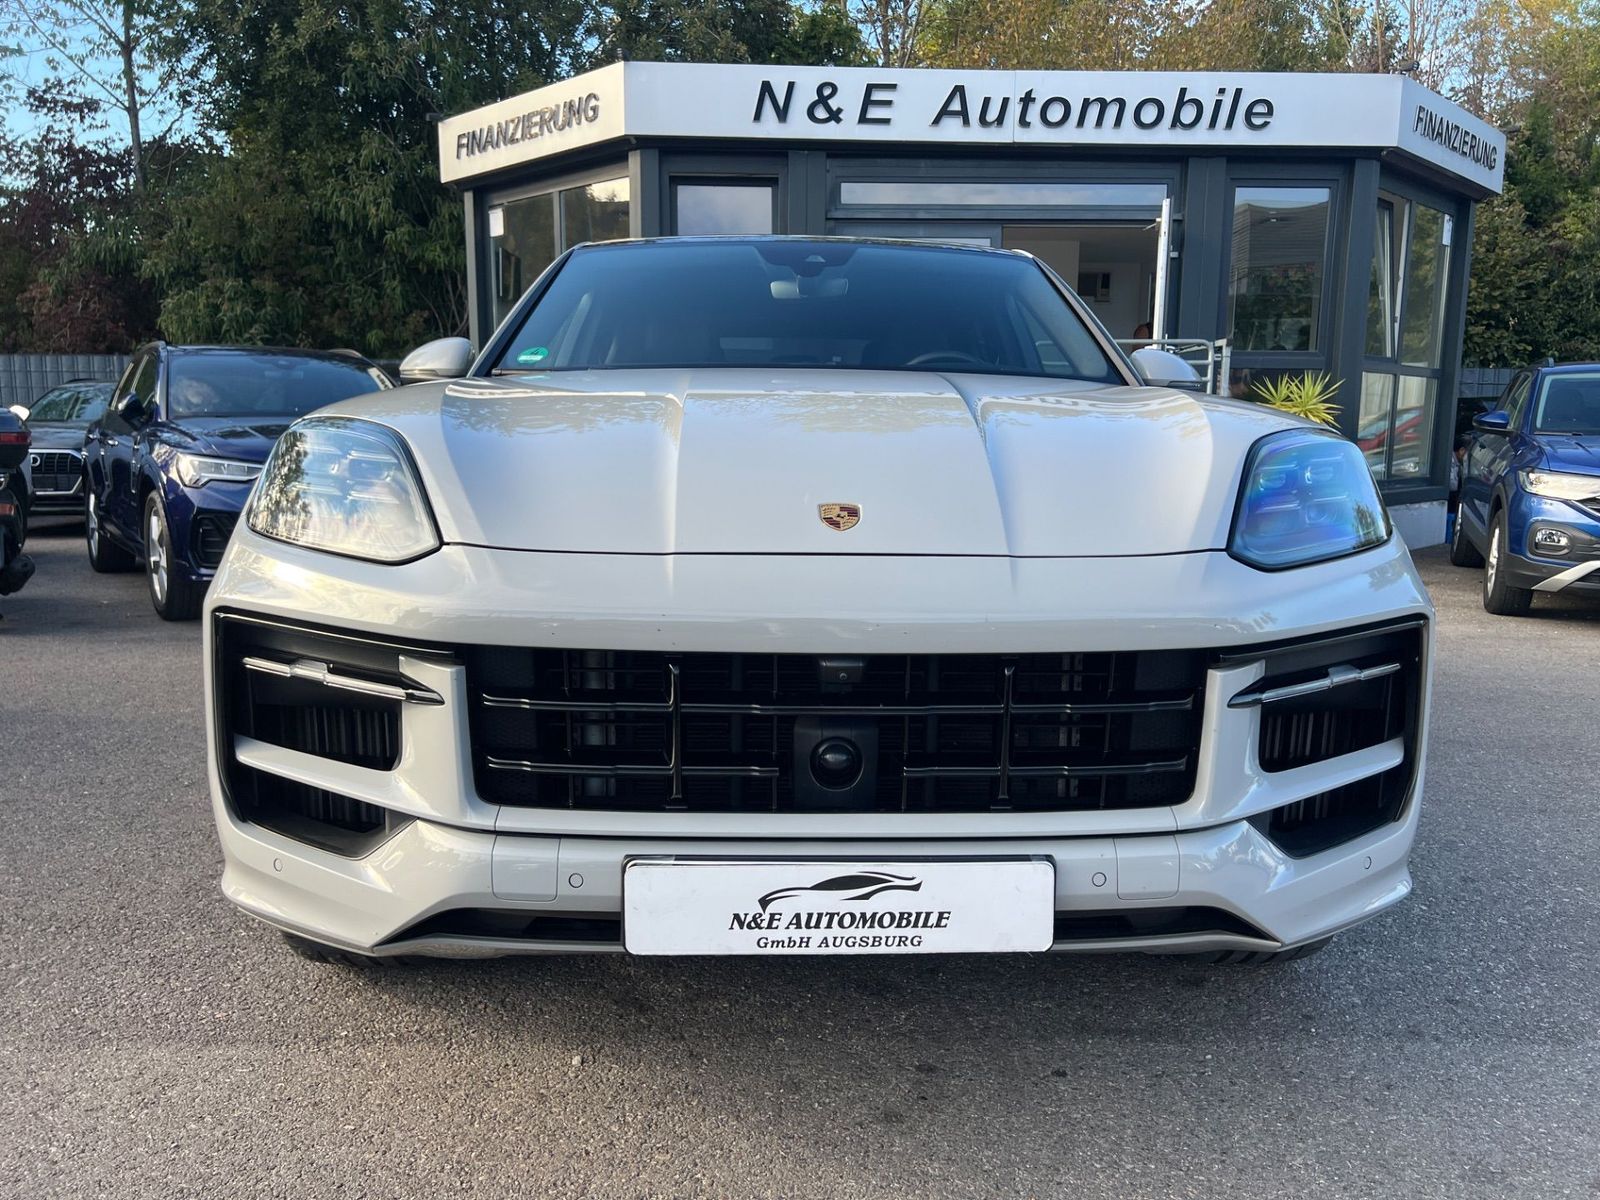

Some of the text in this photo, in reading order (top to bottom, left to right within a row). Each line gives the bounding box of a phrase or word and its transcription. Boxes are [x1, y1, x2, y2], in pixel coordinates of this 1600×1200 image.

[456, 93, 600, 159] FINANZIERUNG
[930, 84, 1275, 131] Automobile
[1413, 105, 1498, 171] FINANZIERUNG
[728, 911, 952, 931] N&E AUTOMOBILE
[756, 935, 923, 950] GmbH AUGSBURG
